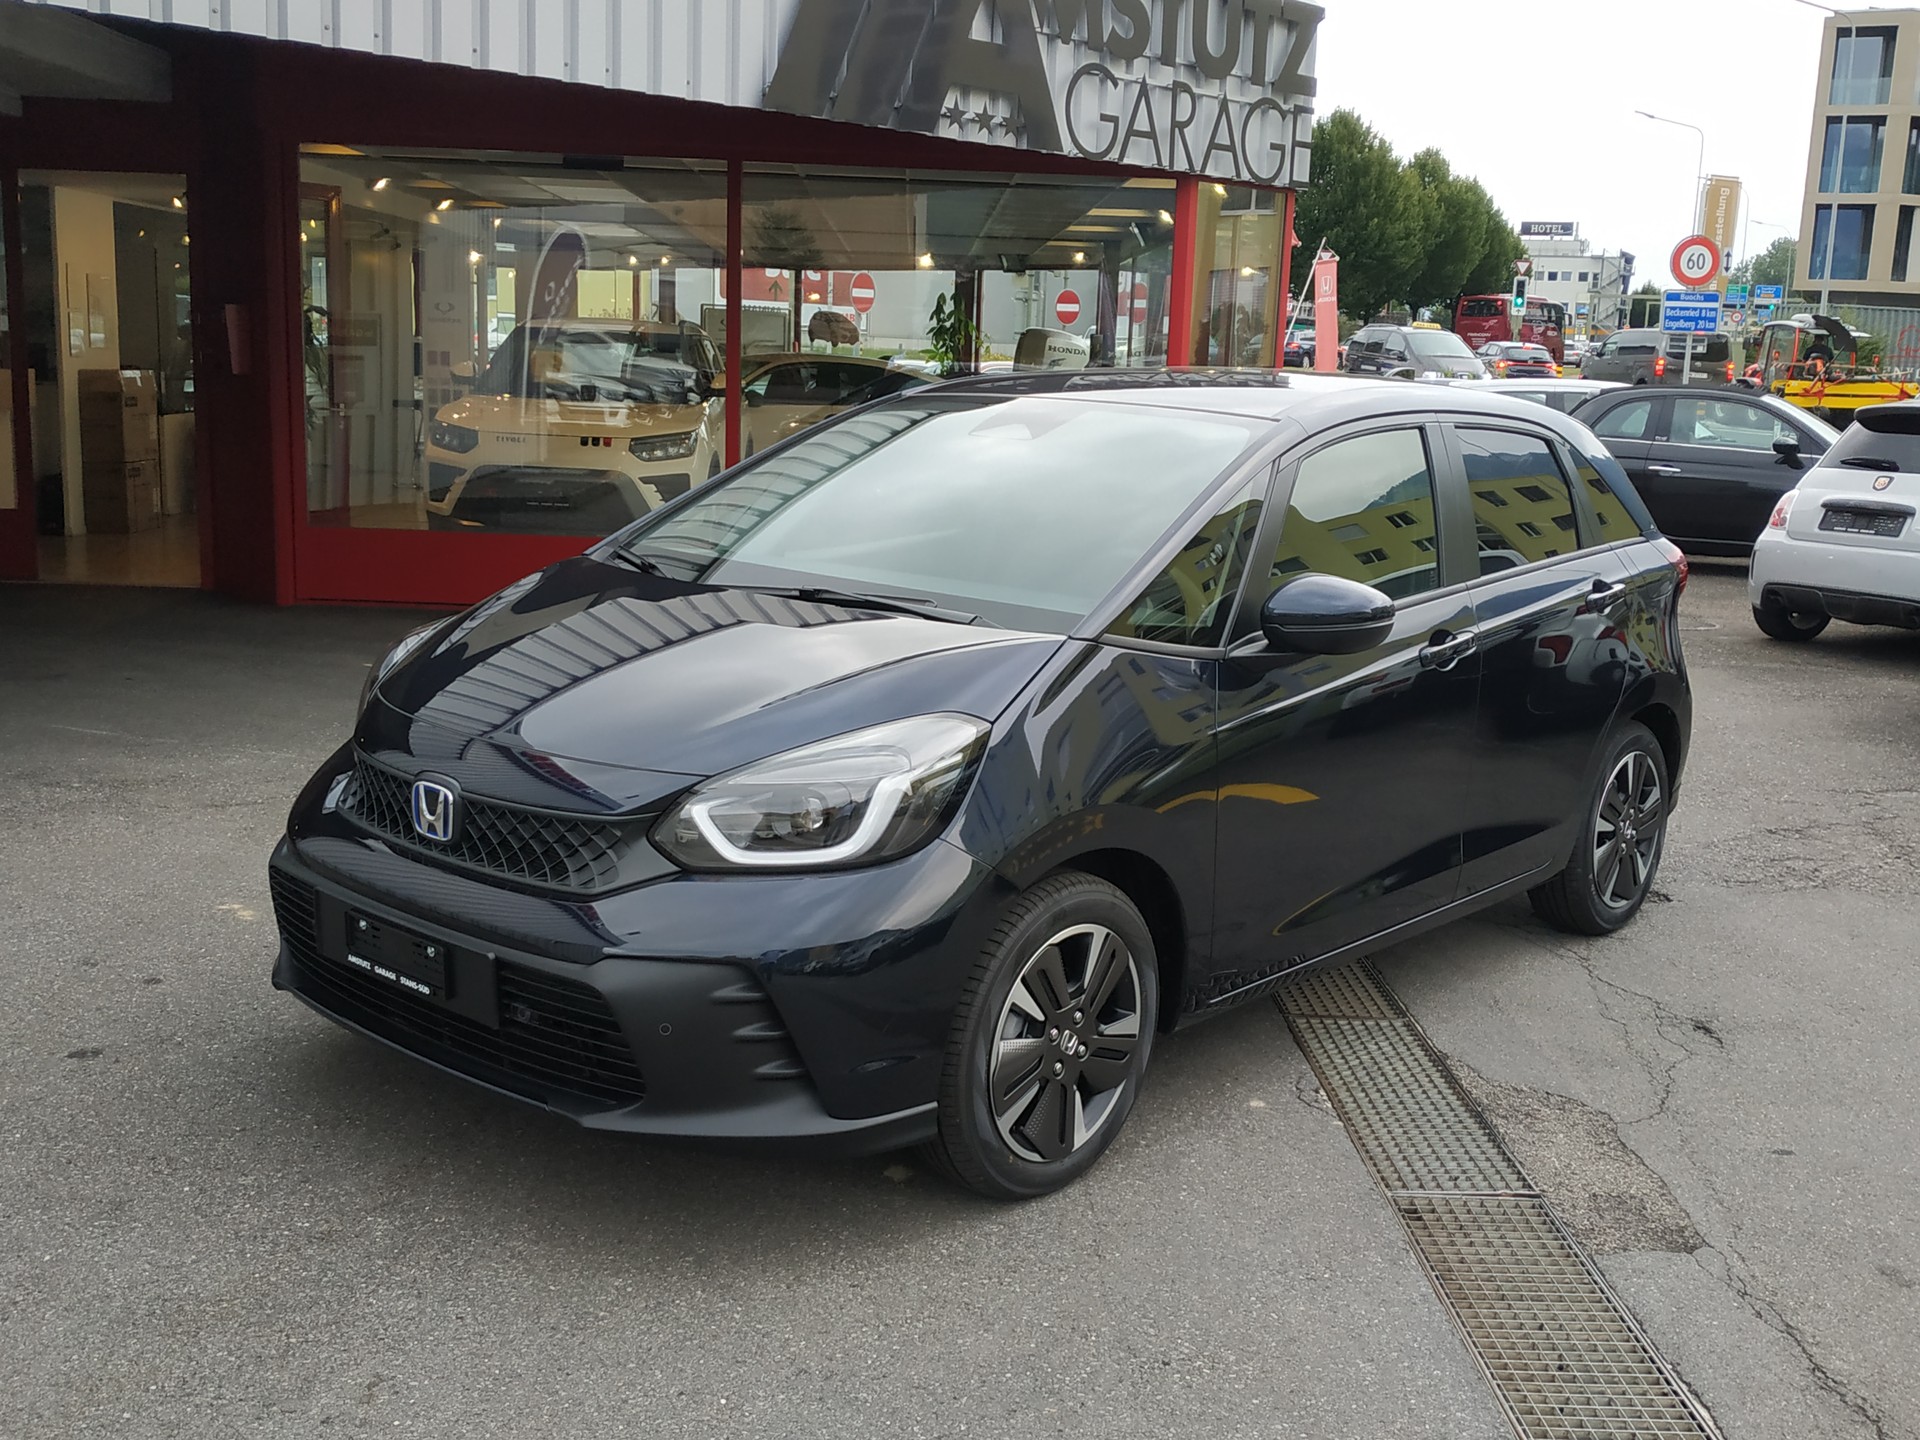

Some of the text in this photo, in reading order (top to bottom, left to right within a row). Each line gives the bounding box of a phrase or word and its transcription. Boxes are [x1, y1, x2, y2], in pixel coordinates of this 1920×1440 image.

[1065, 62, 1315, 189] GARAGE
[1530, 224, 1564, 233] HOTEL
[1686, 252, 1706, 270] 60
[1706, 308, 1716, 318] km
[1664, 319, 1715, 330] Engelberg 20 km
[1047, 344, 1087, 356] HONDA
[374, 965, 397, 981] GARAGE
